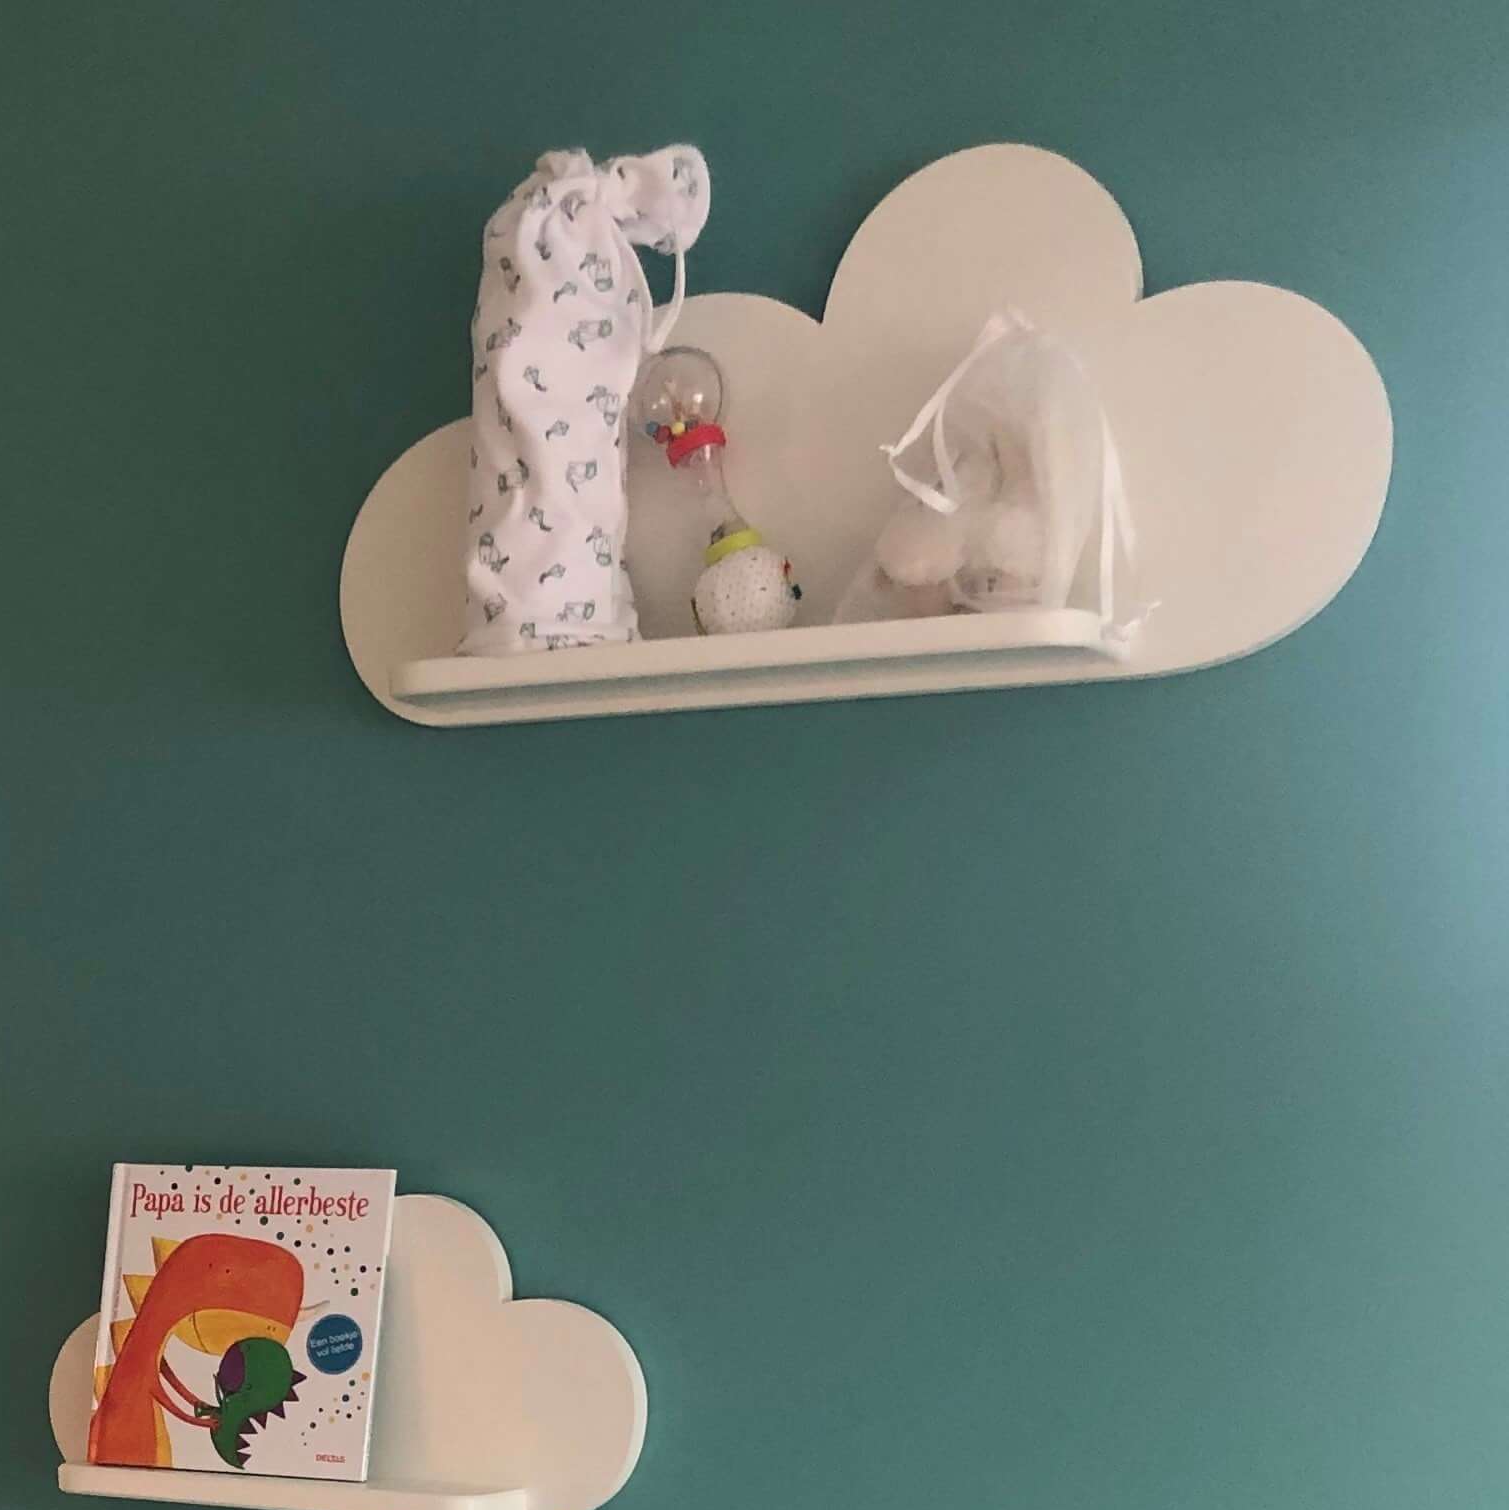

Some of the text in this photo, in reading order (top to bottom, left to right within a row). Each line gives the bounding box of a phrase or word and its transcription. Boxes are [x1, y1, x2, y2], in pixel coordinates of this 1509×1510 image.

[130, 1183, 370, 1221] Papa is de allerbeste
